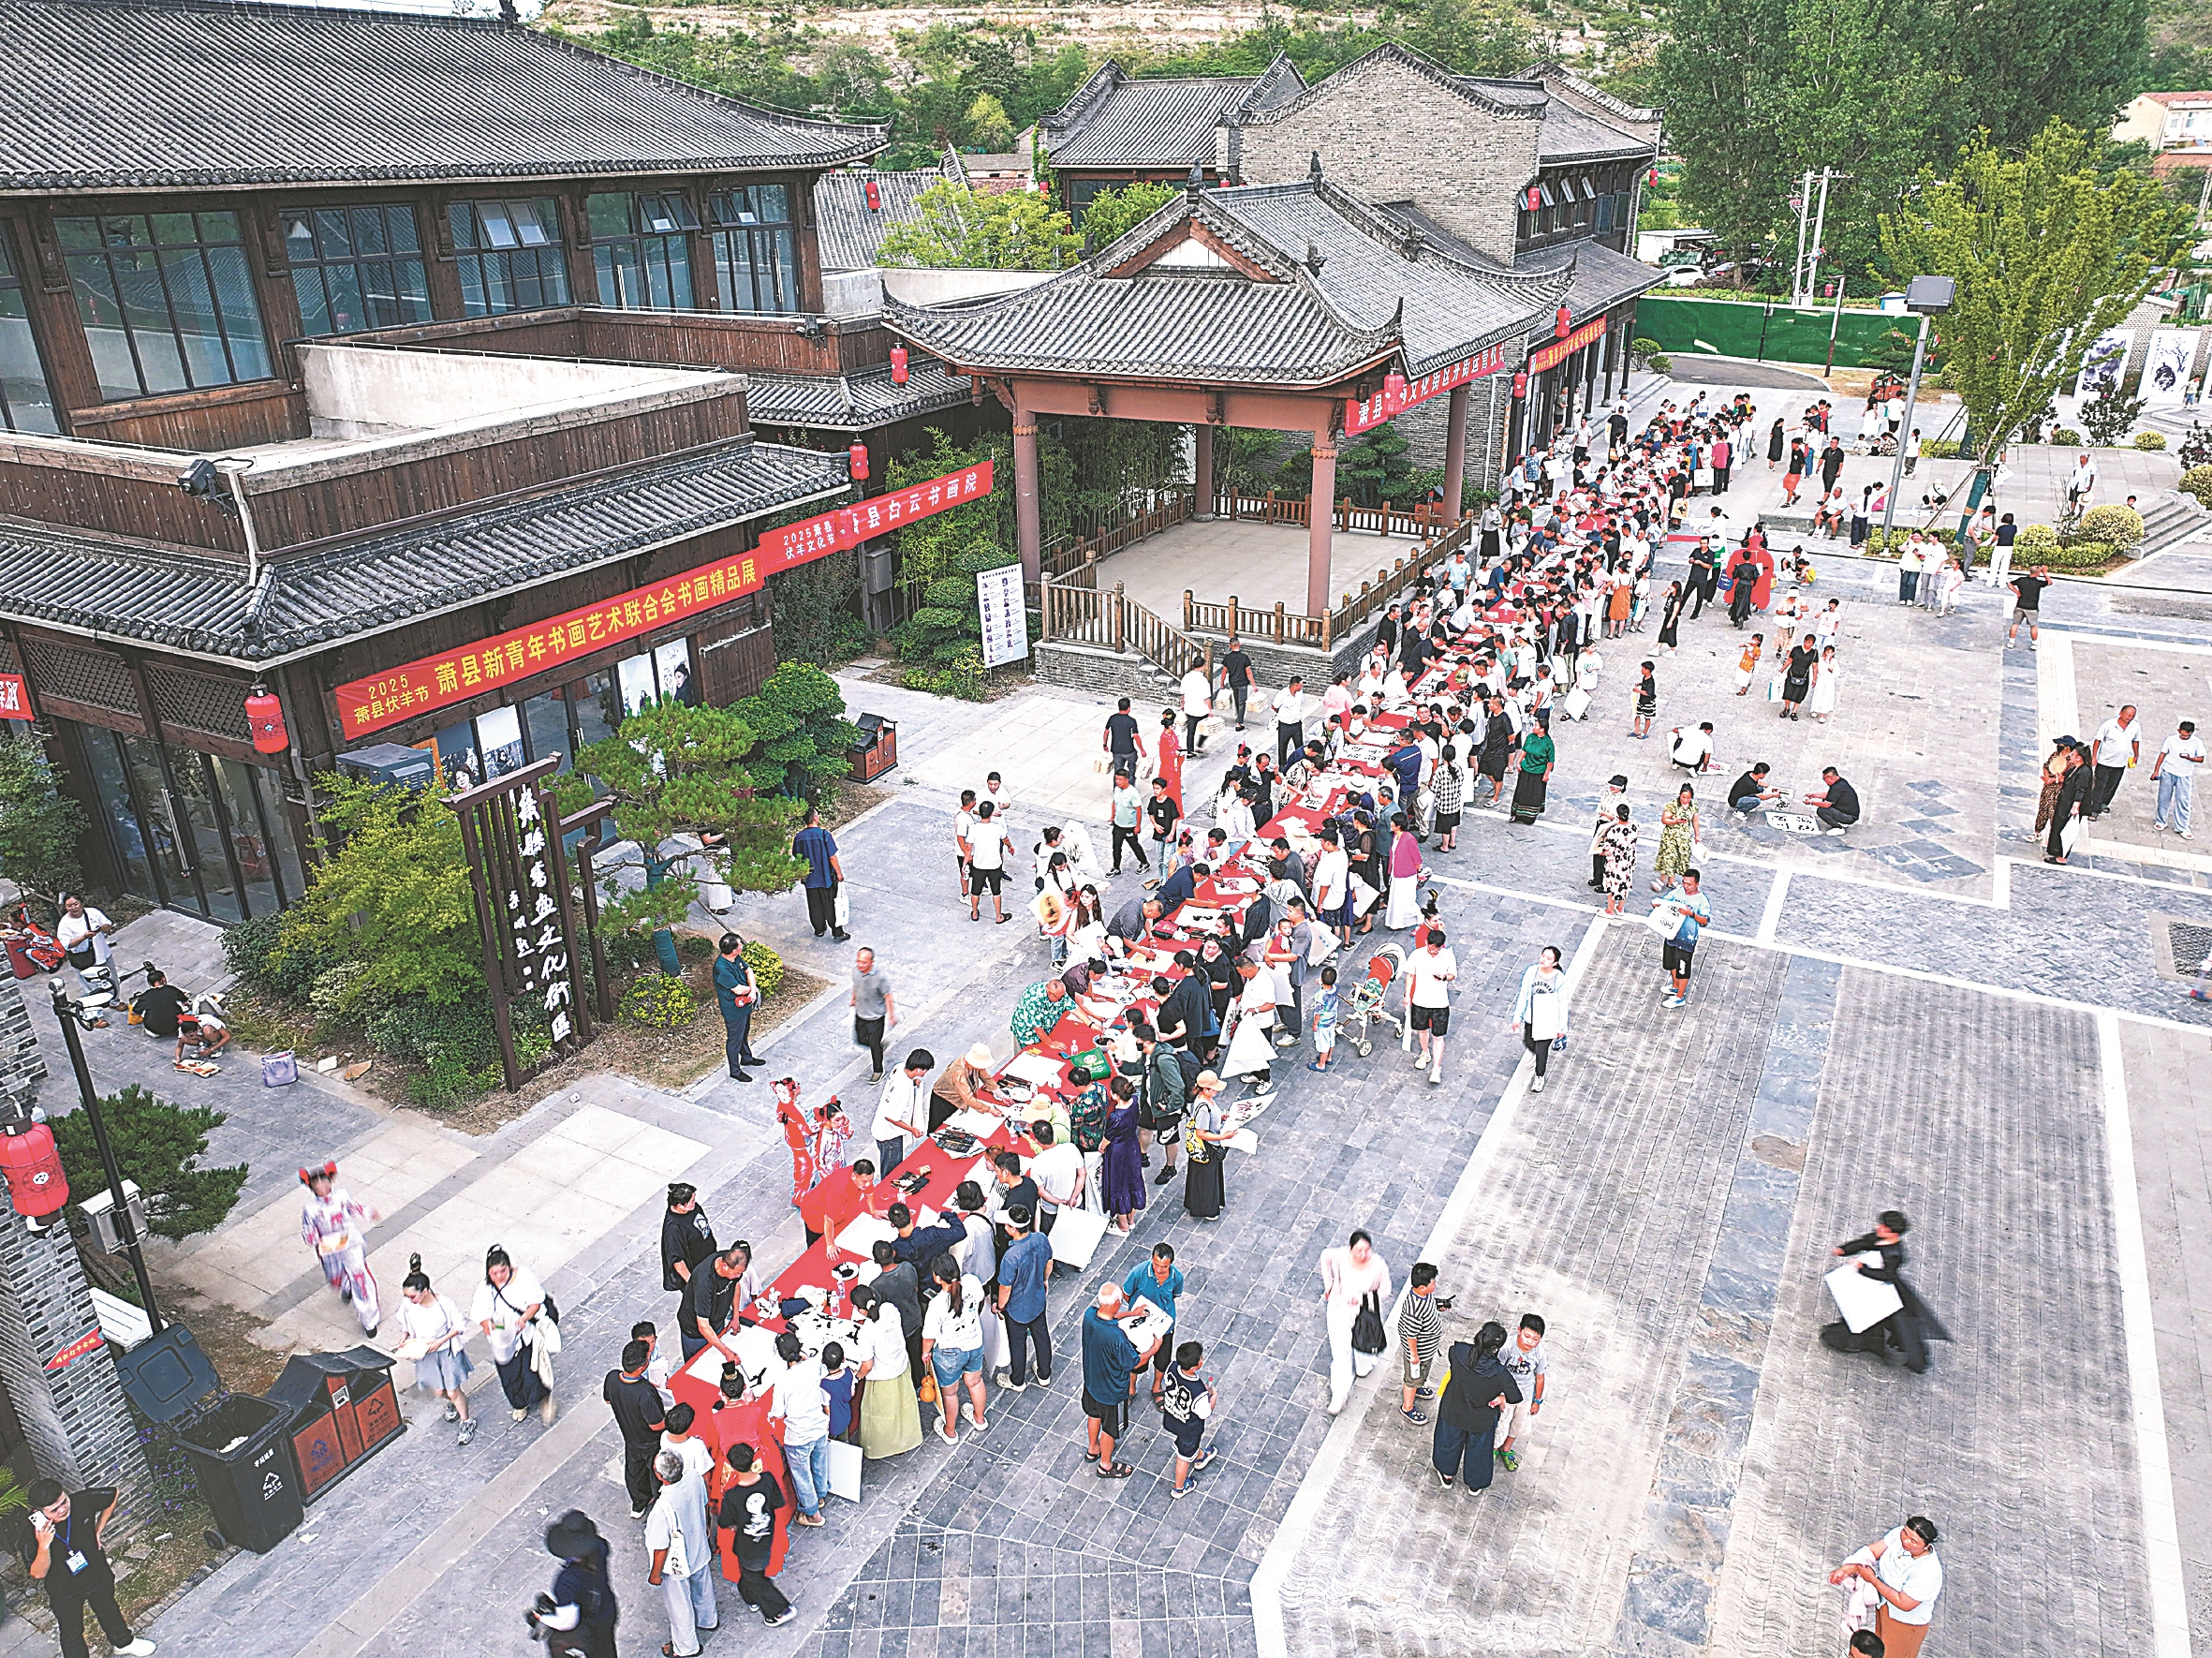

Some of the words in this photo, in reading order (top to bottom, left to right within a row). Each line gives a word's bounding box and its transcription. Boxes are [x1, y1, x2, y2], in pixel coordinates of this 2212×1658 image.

[1357, 344, 1507, 427] 萧县文化街区开街运营仪式
[785, 528, 836, 560] 伏羊文化节
[434, 558, 757, 694] 萧县新青年书画艺术联合会书画精品展
[354, 685, 429, 725] 萧县伏羊节
[368, 674, 412, 707] 2025
